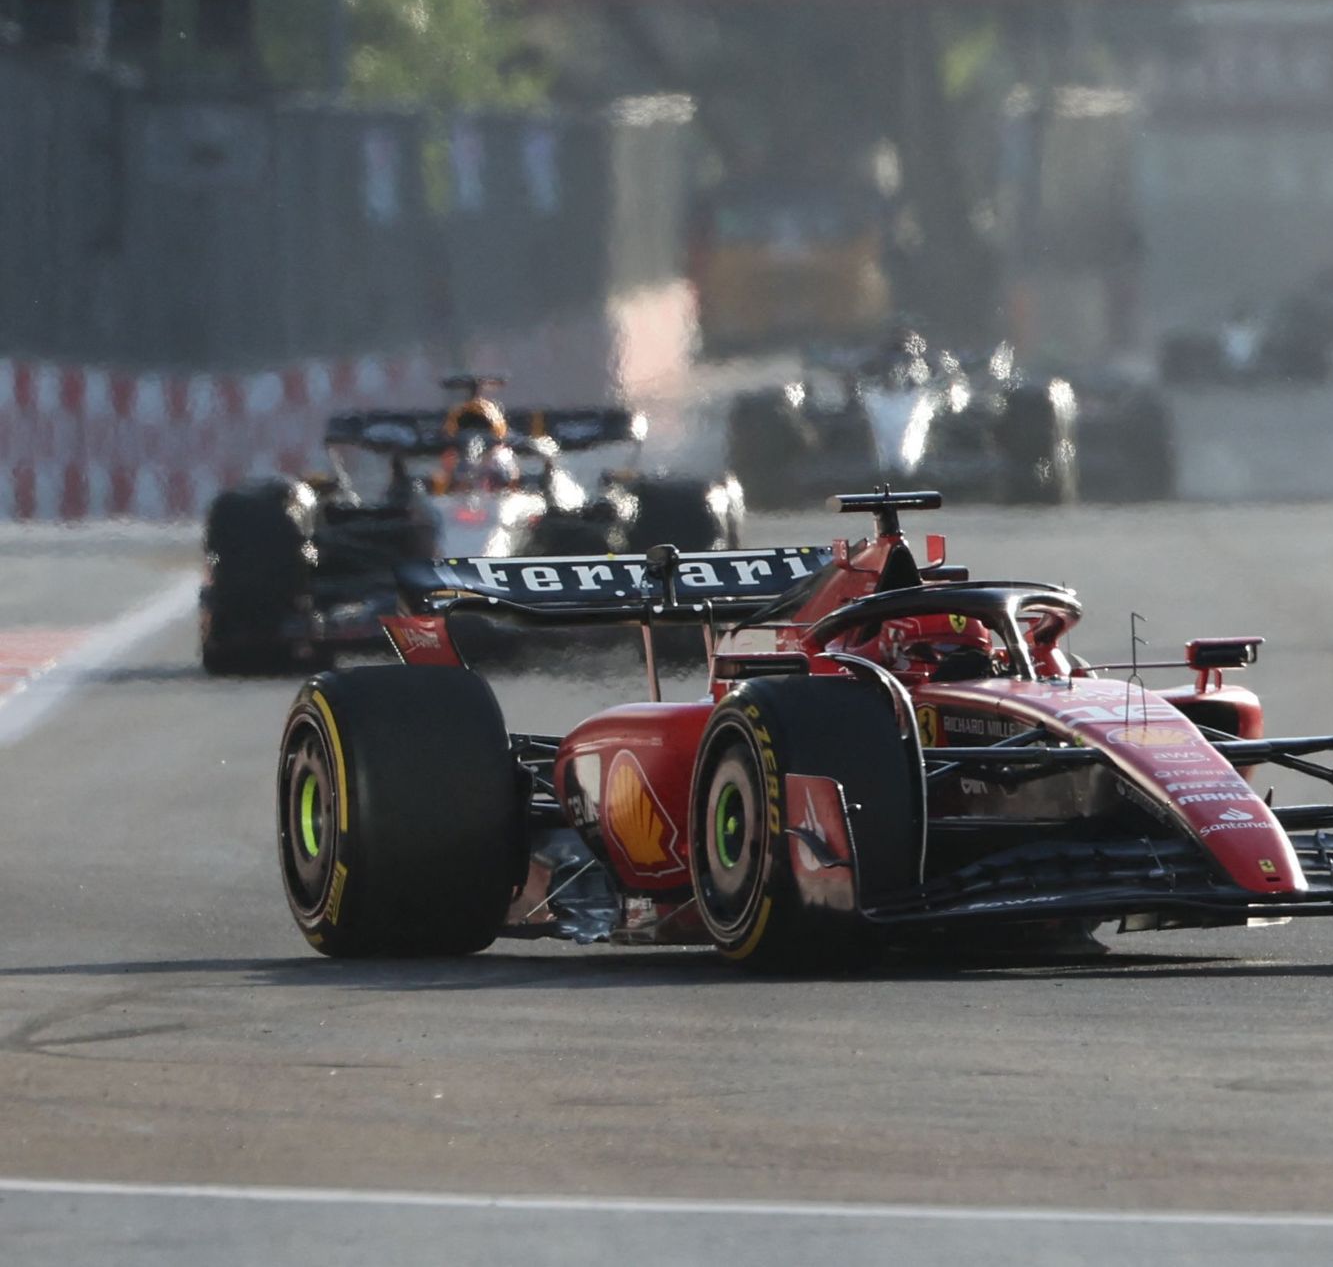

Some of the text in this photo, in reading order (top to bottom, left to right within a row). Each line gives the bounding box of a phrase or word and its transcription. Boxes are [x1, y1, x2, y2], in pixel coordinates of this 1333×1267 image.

[468, 548, 814, 594] Ferrari
[943, 714, 986, 735] RICHARD
[1152, 750, 1207, 762] aws
[1200, 820, 1277, 837] Santand
